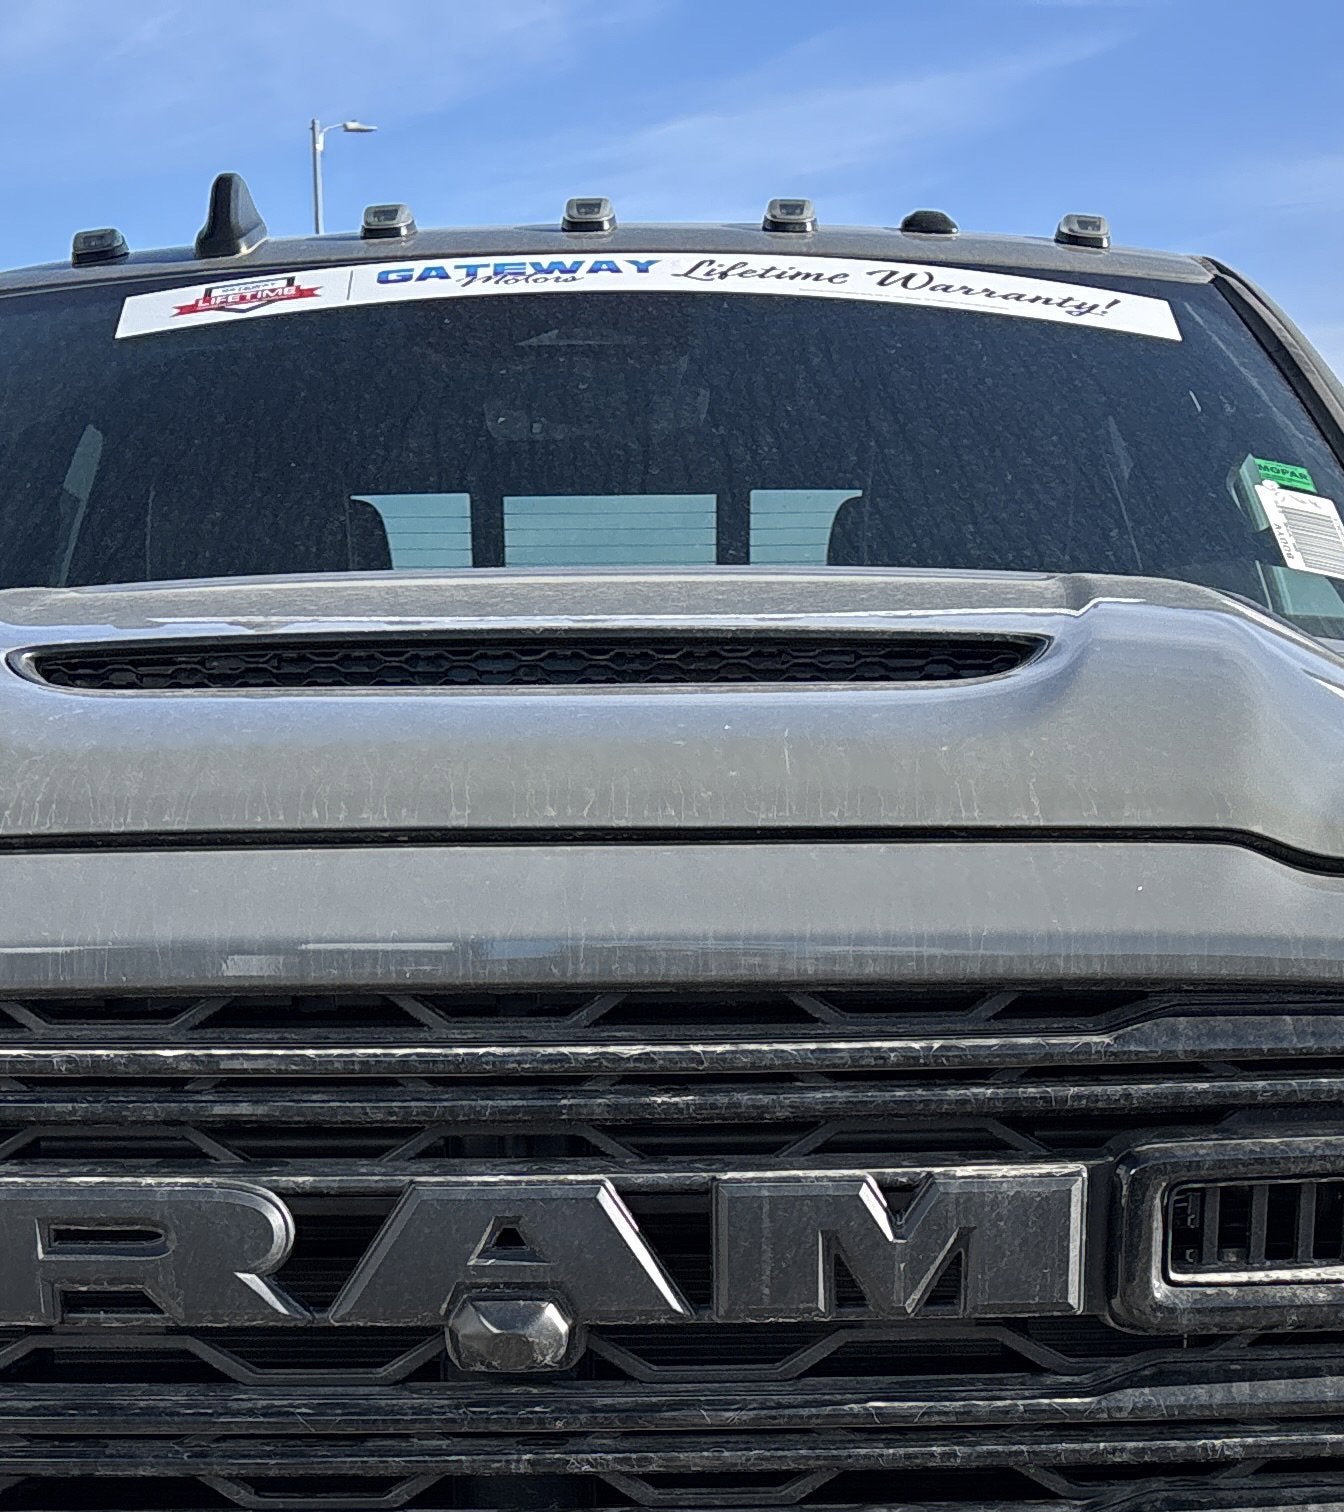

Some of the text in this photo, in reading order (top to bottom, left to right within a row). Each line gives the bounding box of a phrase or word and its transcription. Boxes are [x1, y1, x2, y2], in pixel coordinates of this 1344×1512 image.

[376, 259, 663, 285] GATEWAY
[455, 271, 585, 288] Motors
[197, 285, 297, 308] LIFETIME
[671, 258, 850, 285] Lifetime
[865, 268, 1122, 317] Warranty!
[1257, 463, 1309, 481] MOPAR
